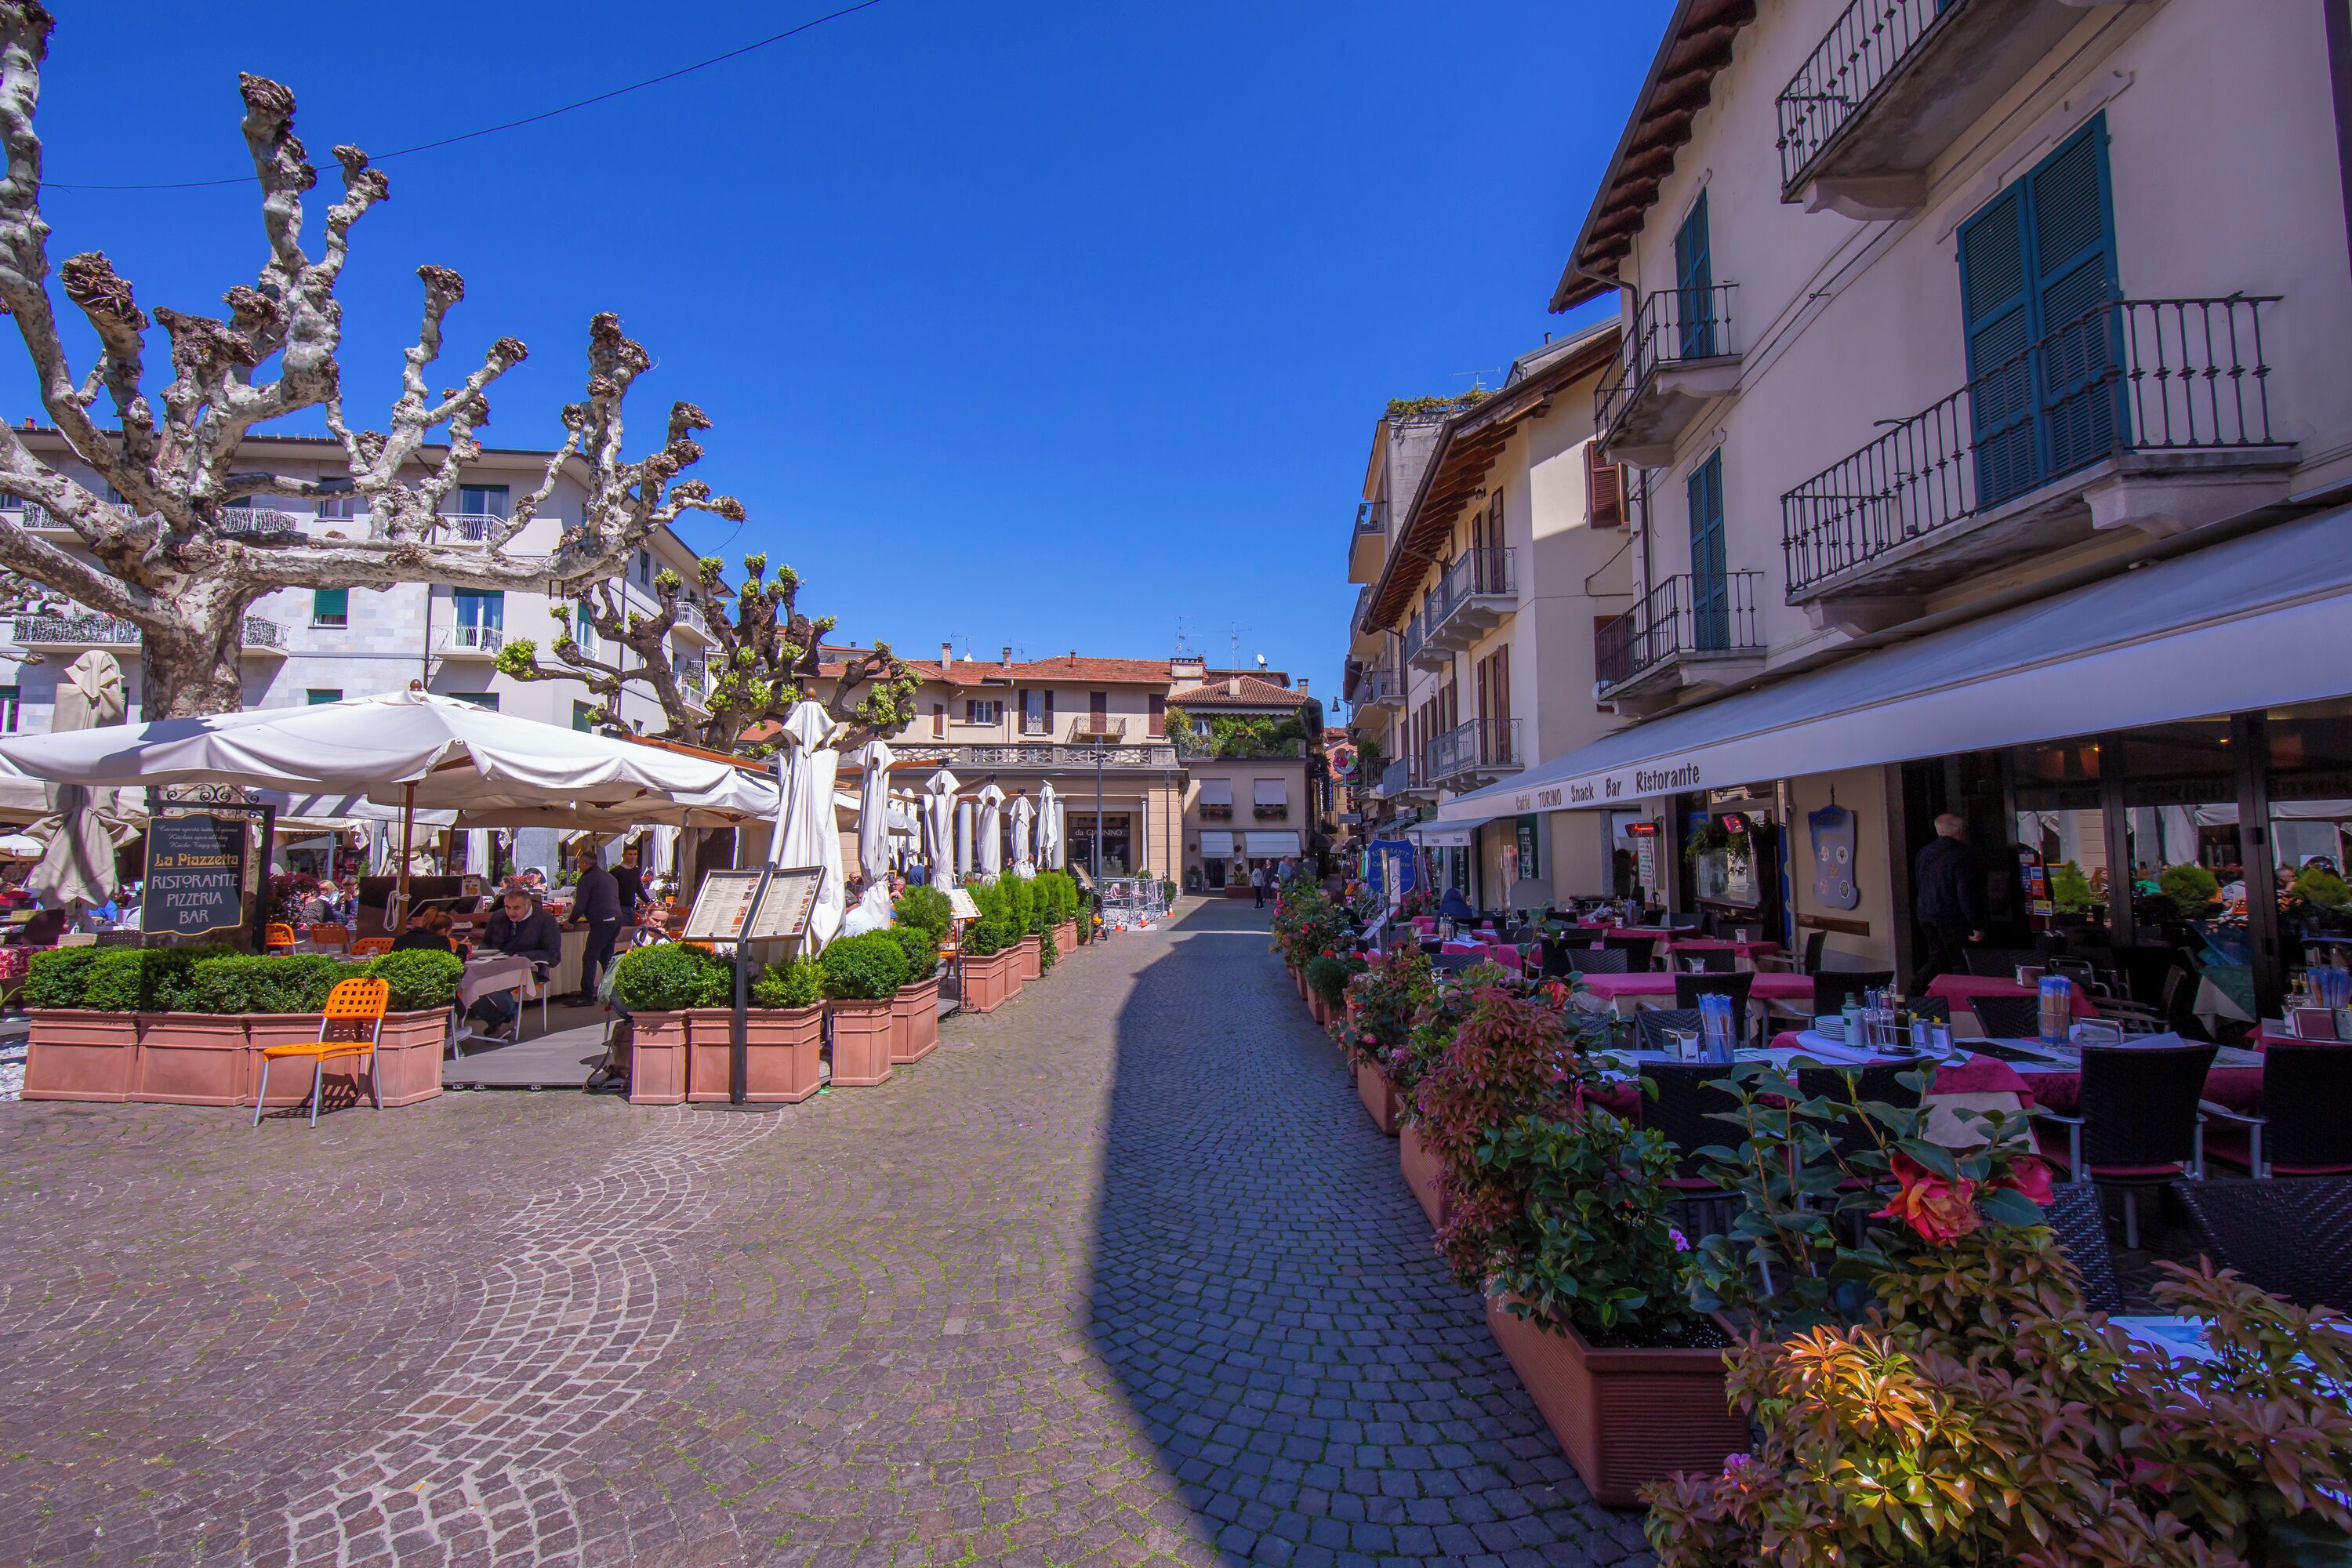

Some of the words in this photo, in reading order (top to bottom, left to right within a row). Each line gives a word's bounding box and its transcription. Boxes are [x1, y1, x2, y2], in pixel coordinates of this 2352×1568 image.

[1537, 788, 1562, 808] TORINO
[1571, 782, 1594, 803] Snack
[1606, 777, 1622, 798] Bar
[1636, 763, 1700, 793] Ristorante
[154, 853, 173, 867] La
[177, 852, 239, 867] Piazzetta
[1371, 848, 1410, 858] RISRANTE
[151, 873, 238, 890] RISTORANTE
[166, 891, 223, 907] PIZZERIA
[179, 909, 209, 924] BAR
